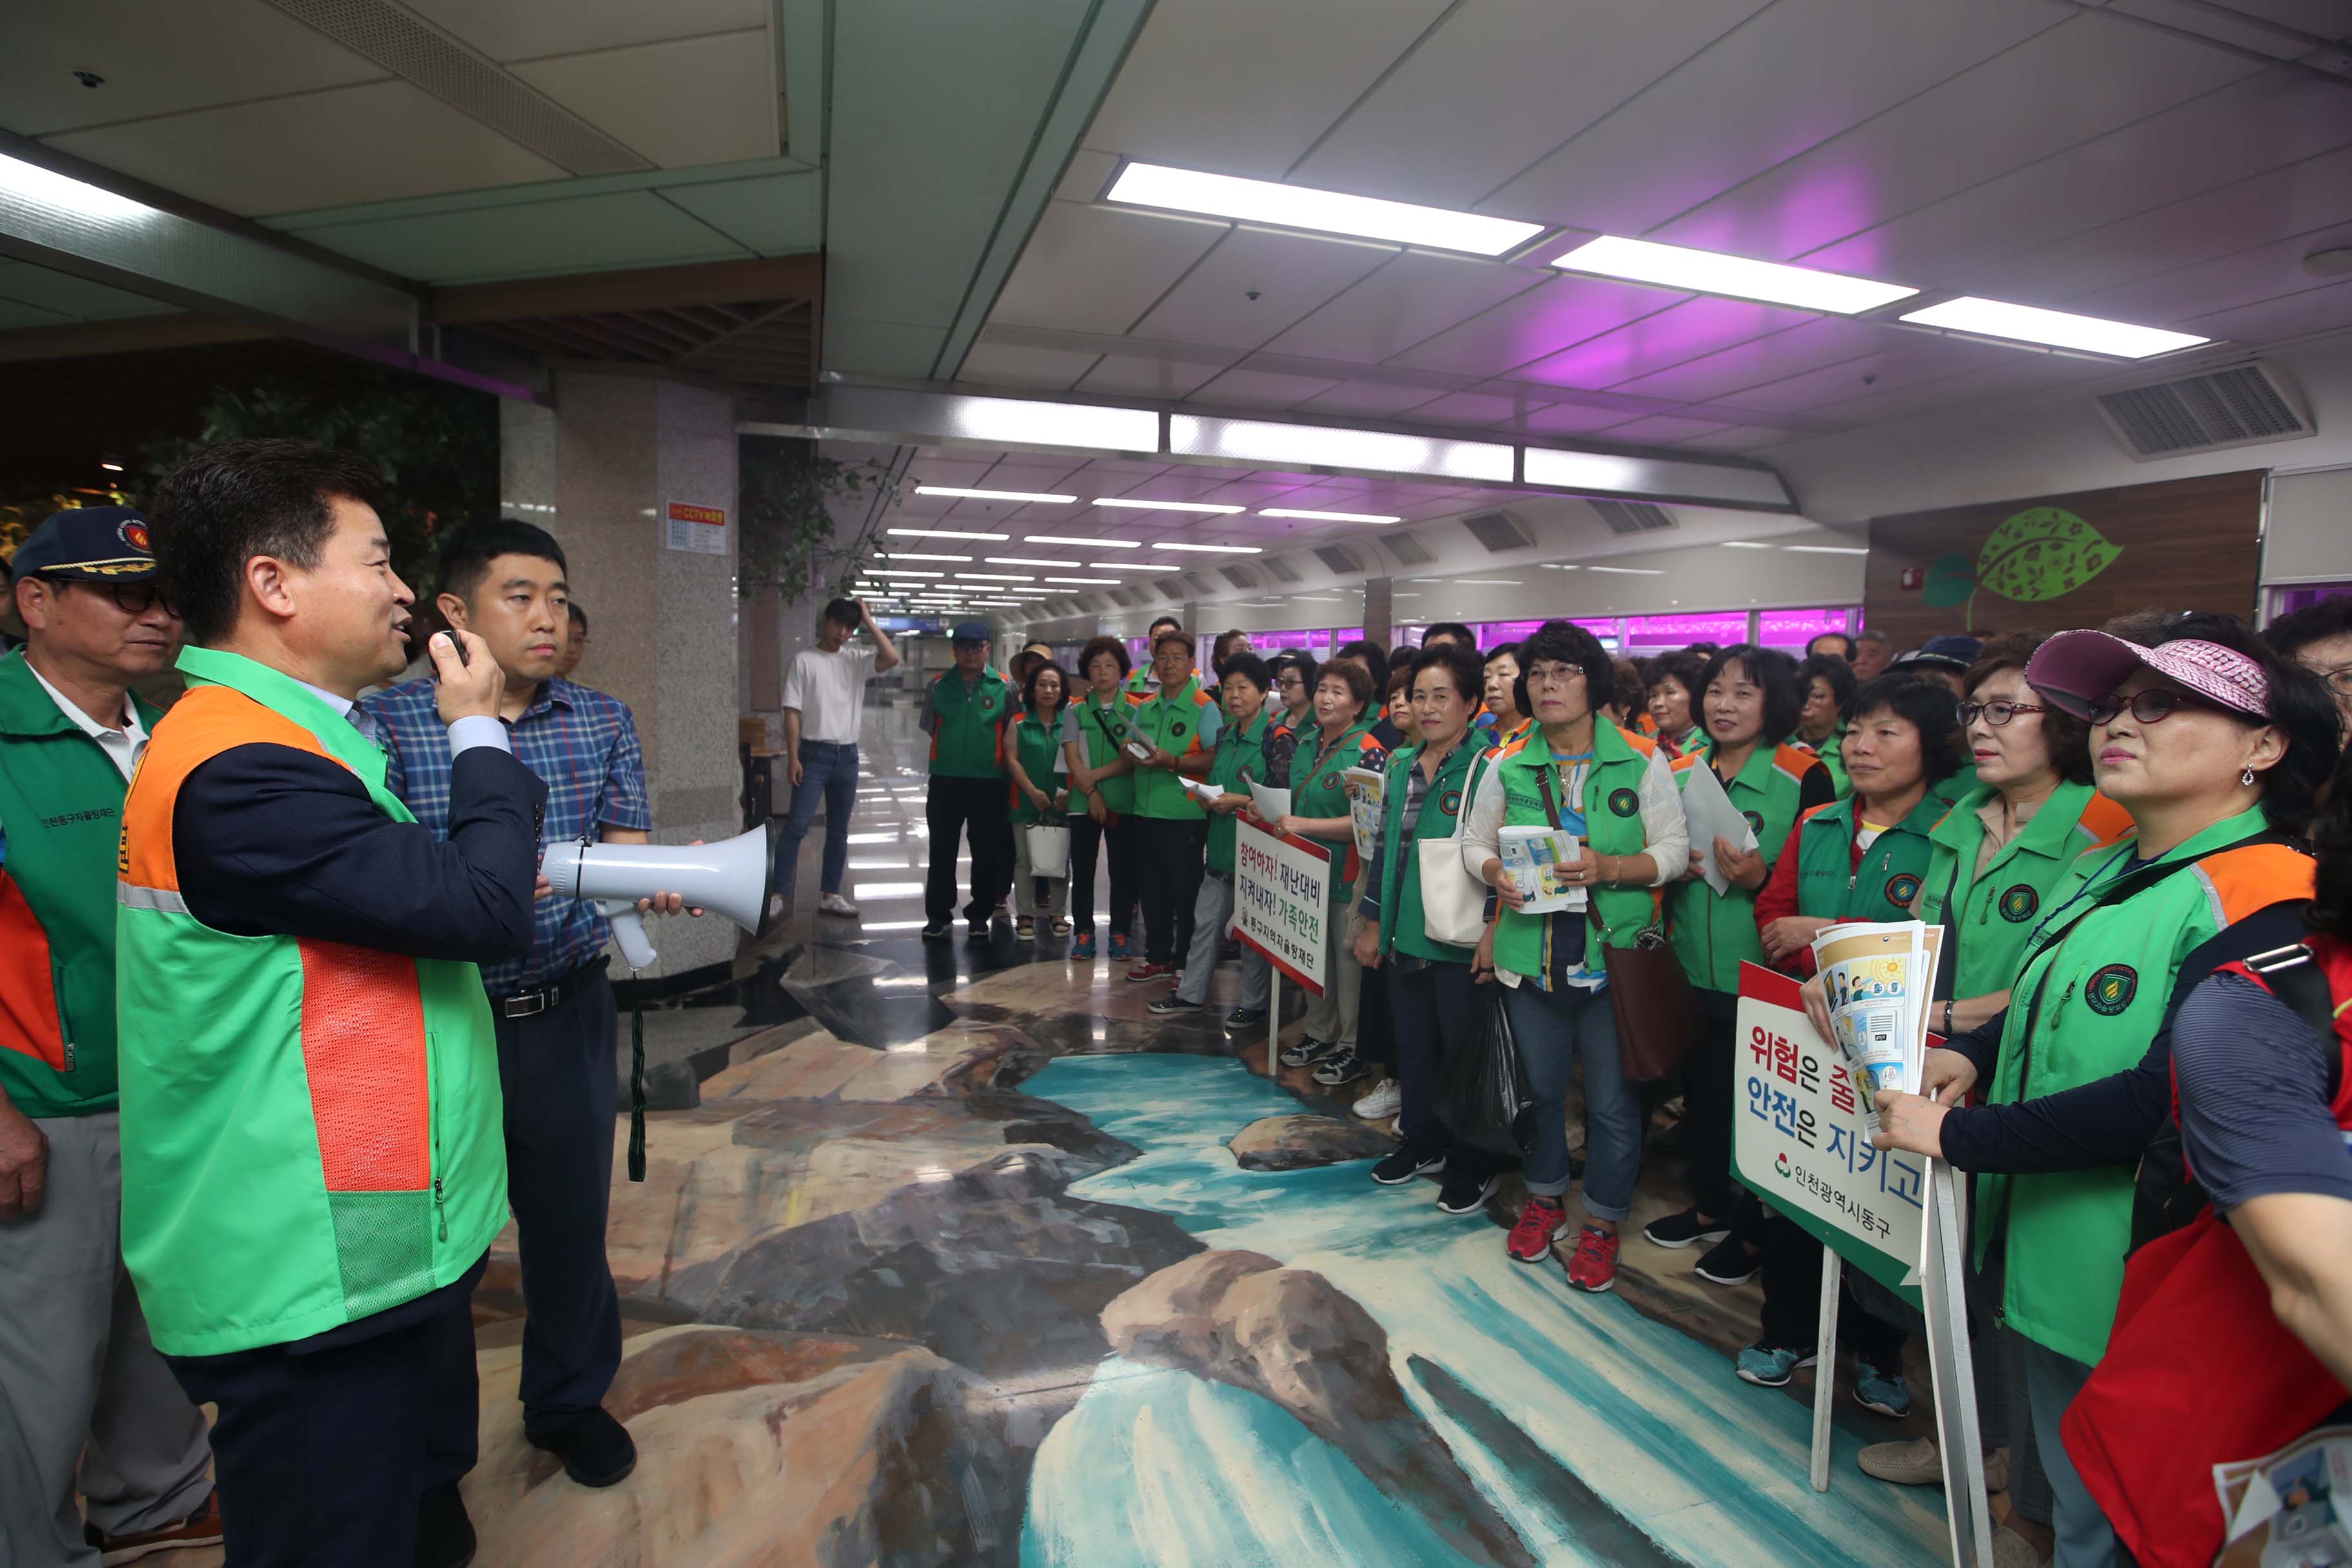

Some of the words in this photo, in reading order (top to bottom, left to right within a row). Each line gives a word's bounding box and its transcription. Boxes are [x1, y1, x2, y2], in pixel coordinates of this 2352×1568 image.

[1239, 874, 1277, 916] 지켜내자!
[1279, 897, 1319, 945] 가족안전
[1240, 841, 1278, 883] 참여하자!
[1280, 863, 1320, 908] 재난대비
[1251, 916, 1315, 970] 동구지역자율방재단
[1750, 1026, 1821, 1095] 위험은
[1747, 1076, 1818, 1150] 안전은
[1826, 1122, 1923, 1210] 지키고
[1795, 1166, 1891, 1239] 인천광역시동구
